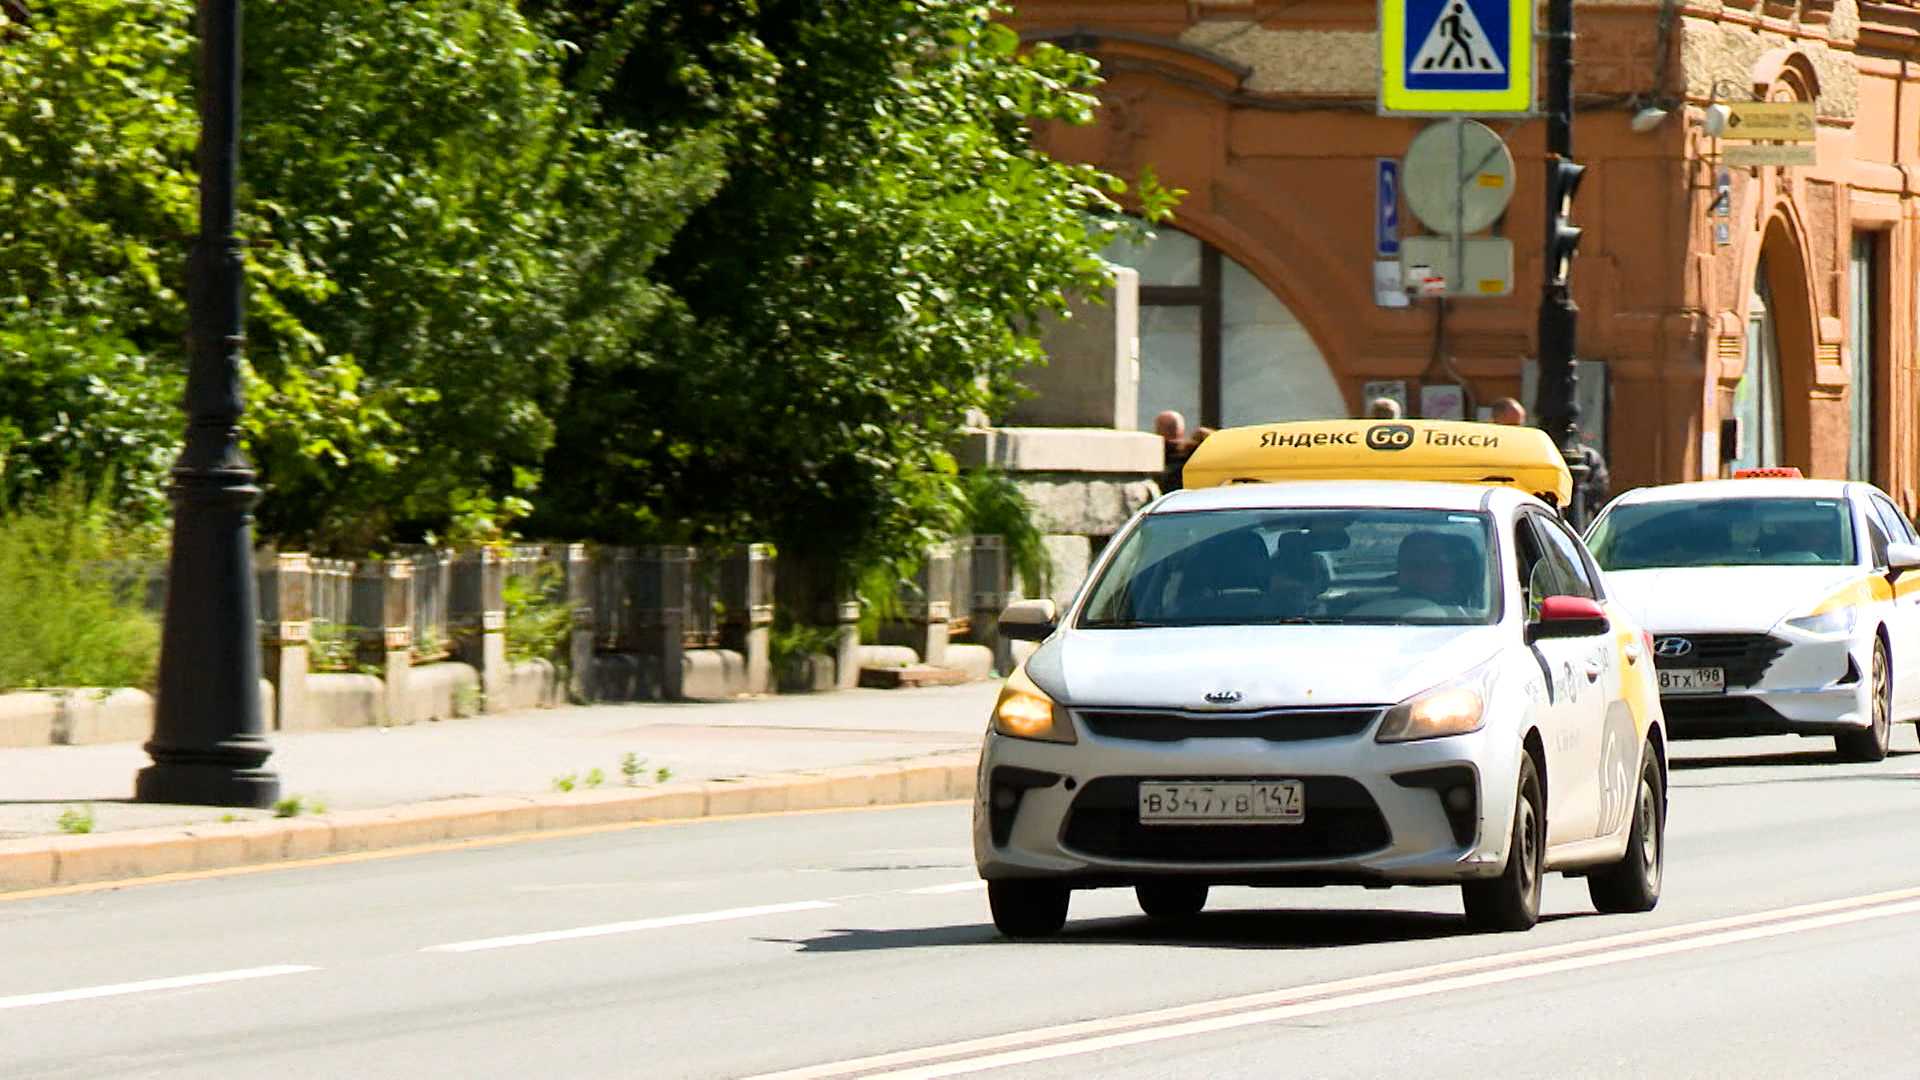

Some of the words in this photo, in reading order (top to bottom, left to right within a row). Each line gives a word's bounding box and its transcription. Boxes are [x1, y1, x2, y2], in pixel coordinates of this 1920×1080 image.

[1260, 431, 1360, 448] Яндекс
[1370, 427, 1411, 446] Go
[1422, 429, 1499, 448] Такси
[1696, 669, 1720, 682] 198
[1256, 786, 1295, 806] 147
